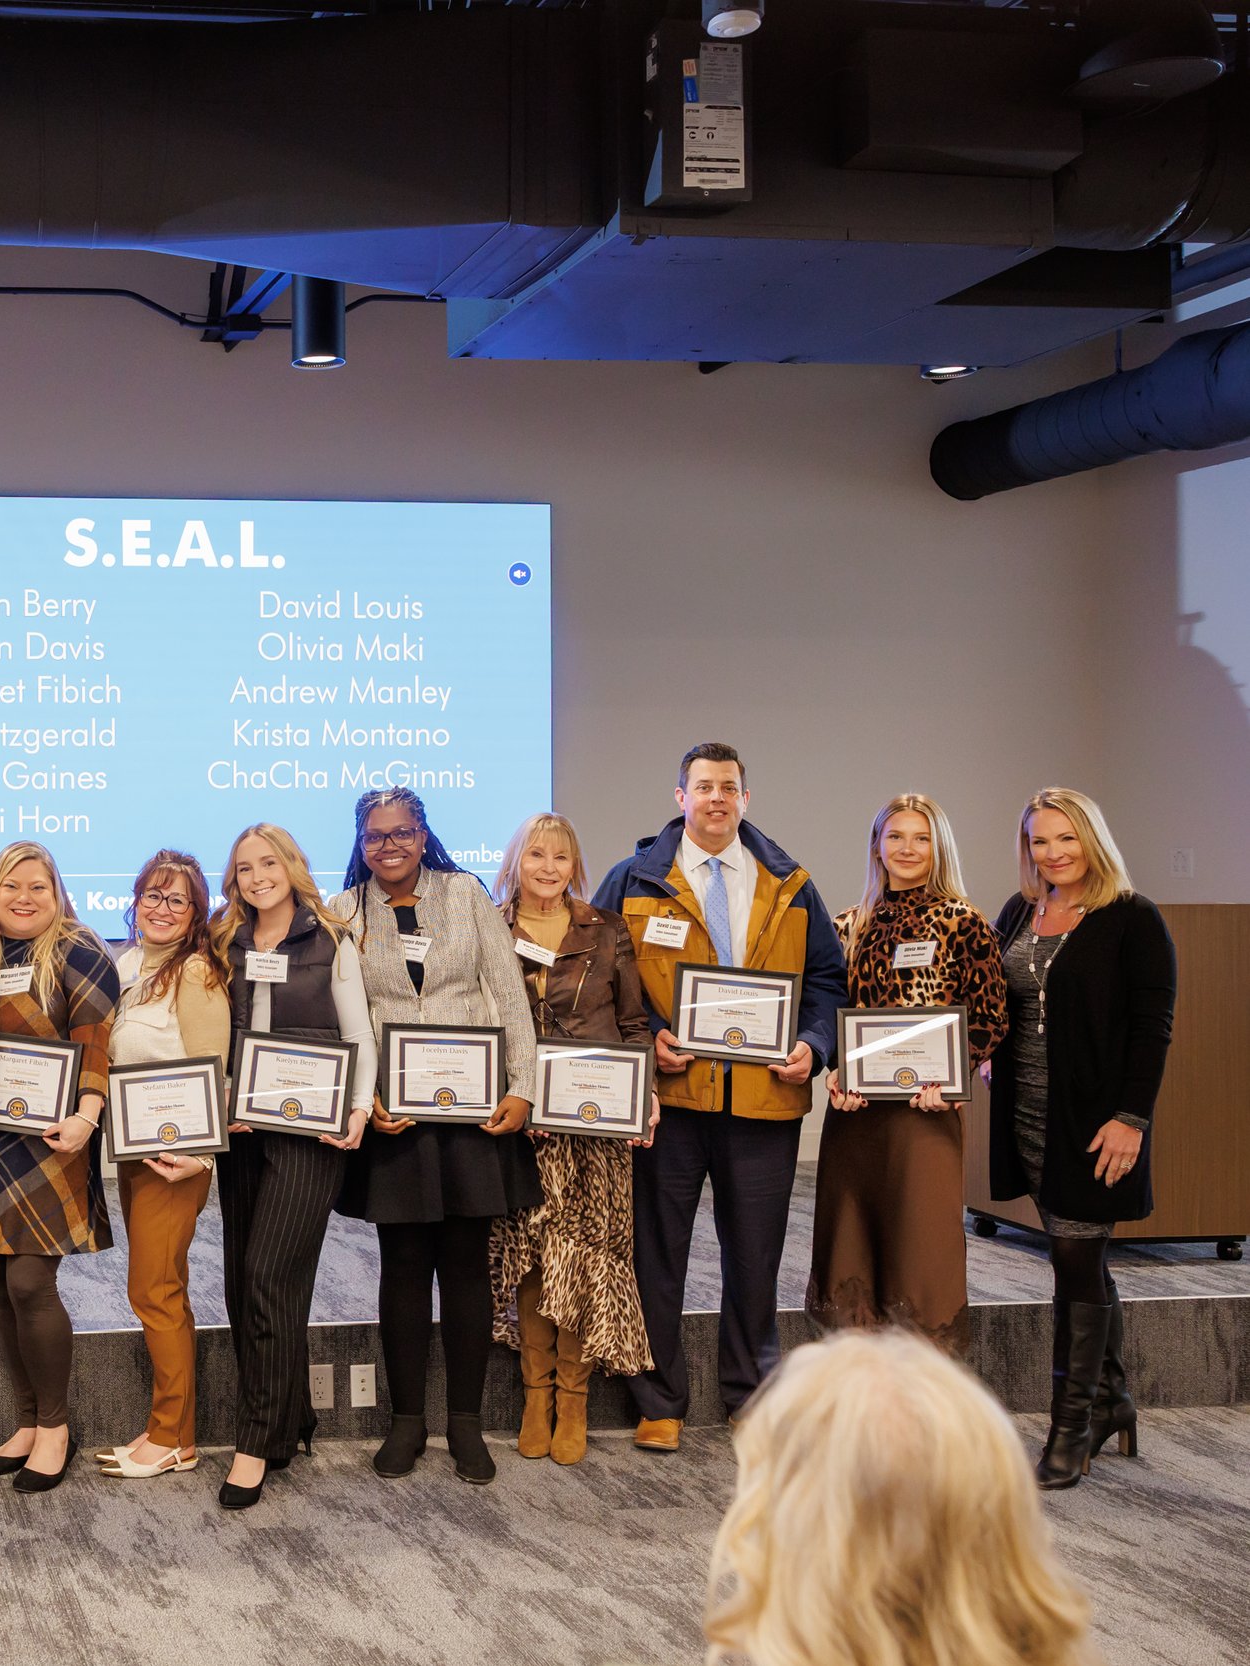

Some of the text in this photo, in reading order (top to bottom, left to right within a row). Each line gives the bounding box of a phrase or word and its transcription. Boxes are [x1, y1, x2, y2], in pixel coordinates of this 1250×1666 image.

[64, 518, 286, 568] S.E.A.L.
[24, 588, 96, 625] Berry
[260, 590, 423, 620] David Louis
[26, 632, 105, 661] Davis
[257, 632, 424, 661] Olivia Maki
[38, 675, 121, 704] Fibich
[230, 674, 452, 711] Andrew Manley
[234, 719, 450, 747] Krista Montano
[2, 761, 107, 790] Gaines
[208, 761, 475, 789] ChaCha McGinnis
[18, 805, 90, 833] Horn
[740, 989, 758, 997] Louis
[0, 1055, 49, 1067] Margaret Fibich
[276, 1056, 318, 1067] Kaelyn Berry
[422, 1046, 447, 1054] Jocelyn
[591, 1062, 615, 1070] Gaines
